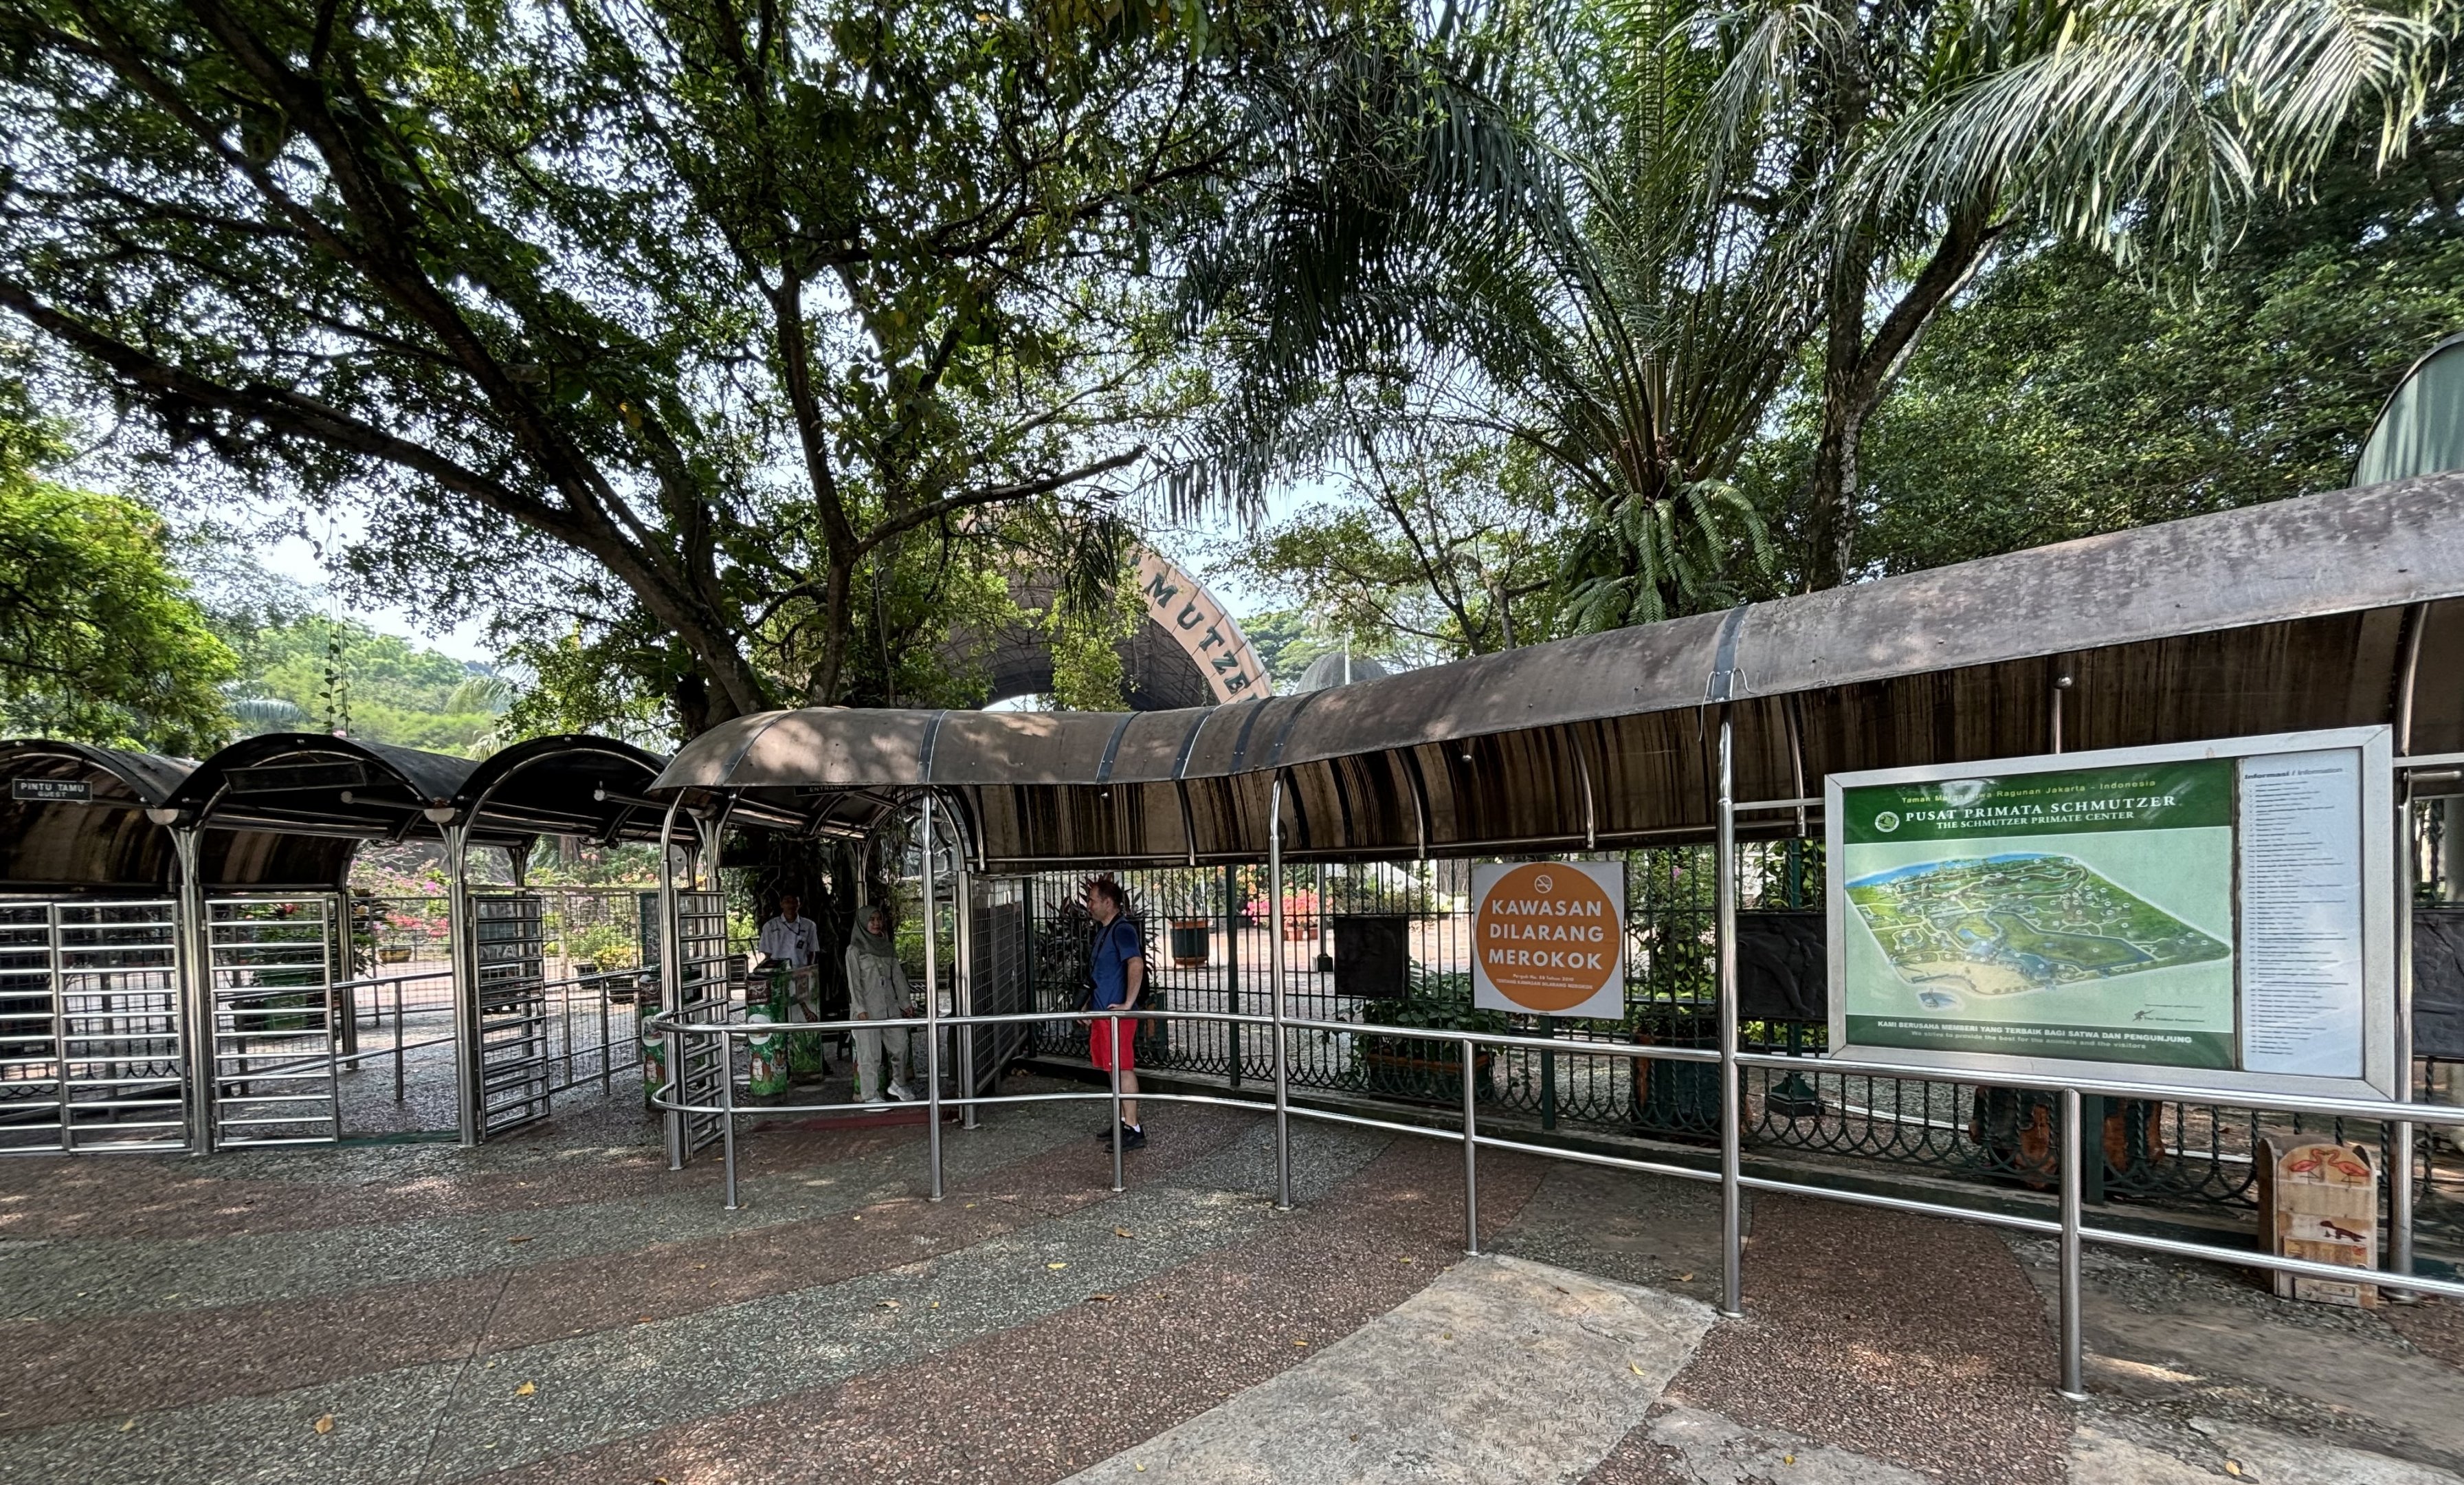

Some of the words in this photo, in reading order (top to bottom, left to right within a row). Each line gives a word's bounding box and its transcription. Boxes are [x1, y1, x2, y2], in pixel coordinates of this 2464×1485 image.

[1137, 567, 1258, 703] MUTZE
[20, 782, 53, 791] PINTU
[57, 784, 85, 792] TAMU
[1996, 789, 2041, 798] Ragunan
[2045, 784, 2086, 794] Jakarta
[2099, 779, 2157, 790] Indonesia
[1905, 809, 1957, 822] PUSAT
[1964, 804, 2043, 819] PRIMATA
[2050, 795, 2176, 813] SCHMUTZER
[1960, 817, 2028, 828] SCHMUTZER
[2031, 814, 2083, 824] PRIMATE
[2085, 811, 2135, 822] CENTER
[1491, 899, 1602, 916] KAWASAN
[1489, 923, 1605, 943] DILARANG
[1488, 948, 1603, 970] MEROKOK
[1878, 1020, 1897, 1028] KAMI
[1898, 1022, 1940, 1031] BERUSAHA
[1941, 1024, 1979, 1032] MEMBERI
[1979, 1025, 2003, 1034] YANG
[2004, 1026, 2042, 1036] TERBAIK
[2044, 1028, 2066, 1037] BAGI
[2067, 1030, 2100, 1039] SATWA
[2123, 1033, 2193, 1044] PENGUNJUNG
[2113, 1042, 2146, 1050] visitors
